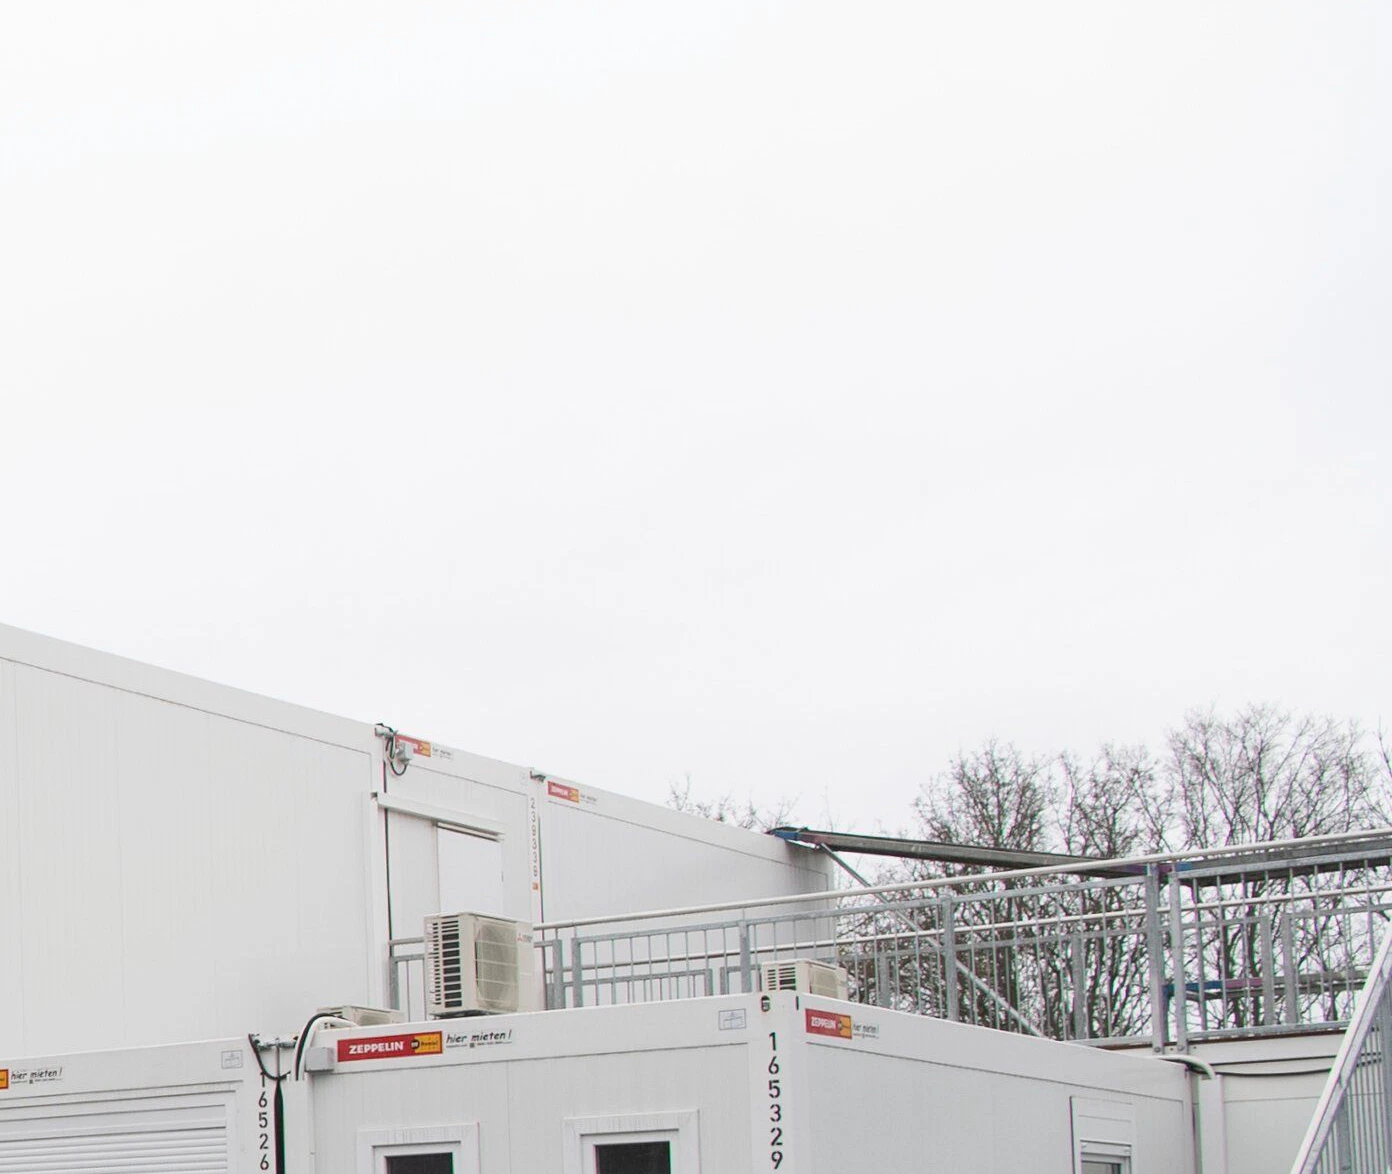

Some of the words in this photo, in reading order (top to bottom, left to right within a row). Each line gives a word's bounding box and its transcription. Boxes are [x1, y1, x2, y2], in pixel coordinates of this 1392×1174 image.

[446, 1033, 467, 1043] hier
[349, 1041, 404, 1055] ZEPPELIN
[11, 1070, 27, 1081] hier
[768, 1032, 783, 1169] 165329
